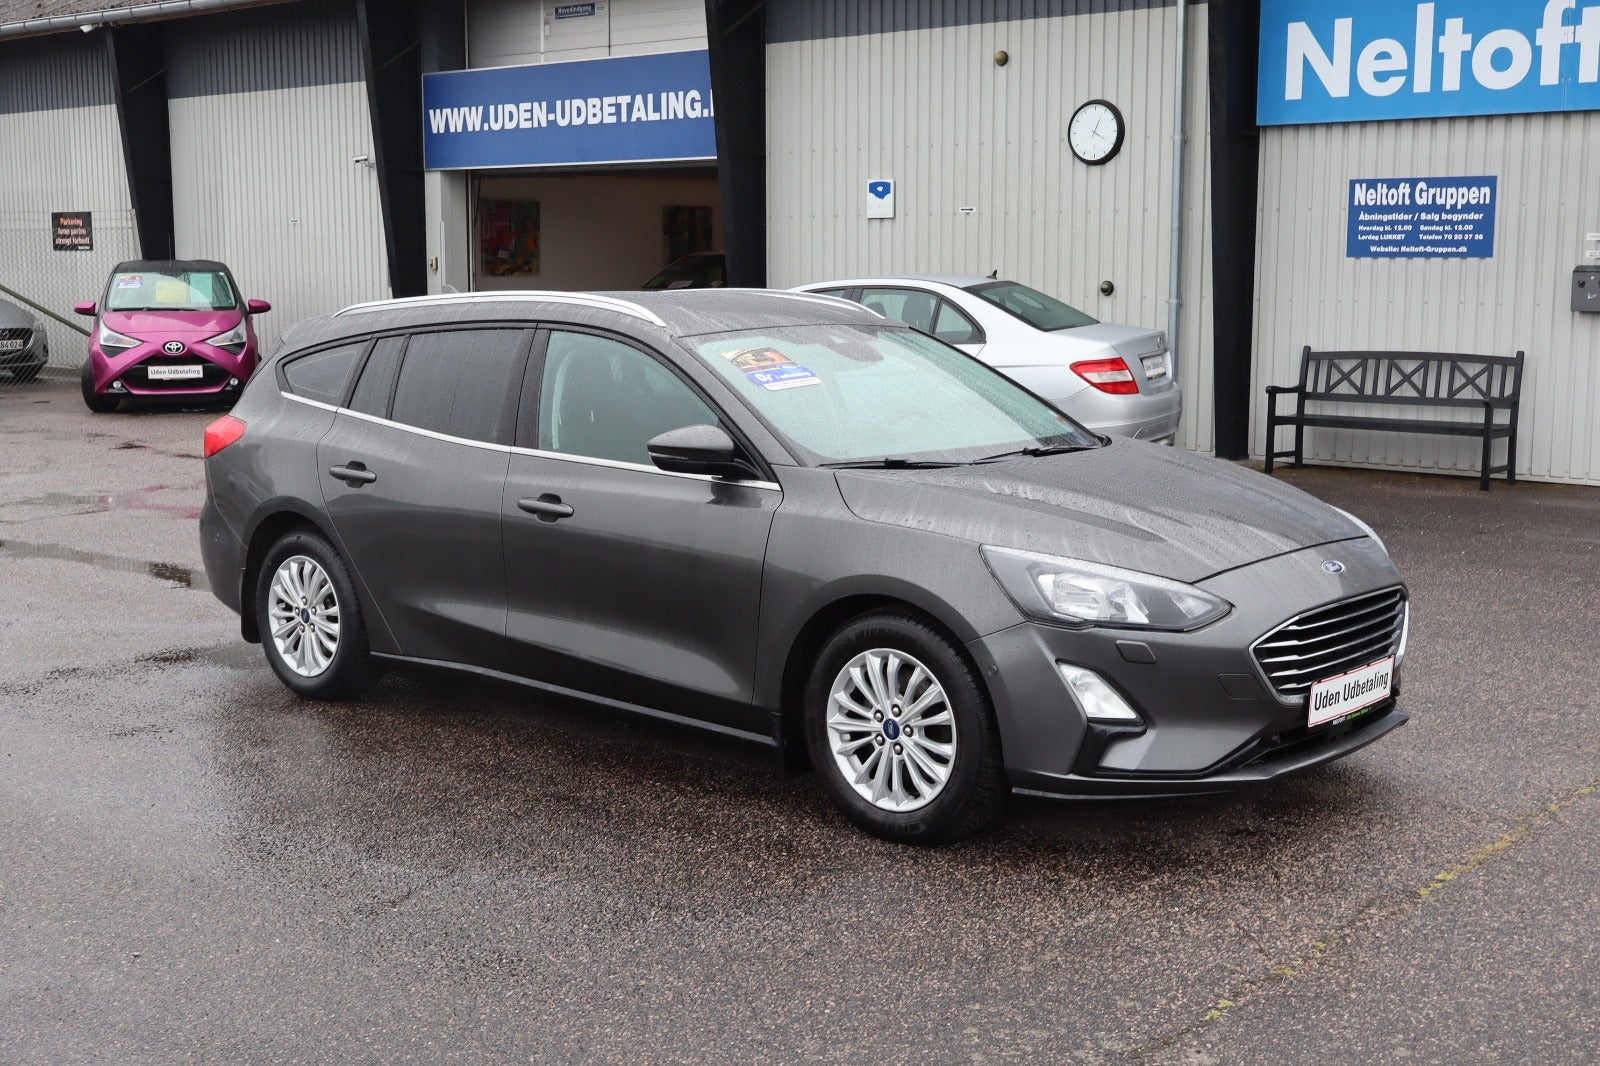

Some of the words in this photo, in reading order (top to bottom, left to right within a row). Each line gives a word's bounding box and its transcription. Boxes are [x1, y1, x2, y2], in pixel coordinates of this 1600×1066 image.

[1284, 0, 1600, 101] Neltoft
[428, 88, 714, 134] WWW.UDEN-UDBETALING.
[1353, 182, 1411, 206] Neltoft
[1414, 181, 1491, 210] Gruppen
[1358, 210, 1413, 222] Åbningstider
[1420, 212, 1440, 222] Salg
[1441, 211, 1484, 222] begynder
[1400, 245, 1468, 254] Neltoft-Gruppen.dk
[1314, 689, 1341, 711] Uden
[1342, 671, 1390, 702] Udbetaling
